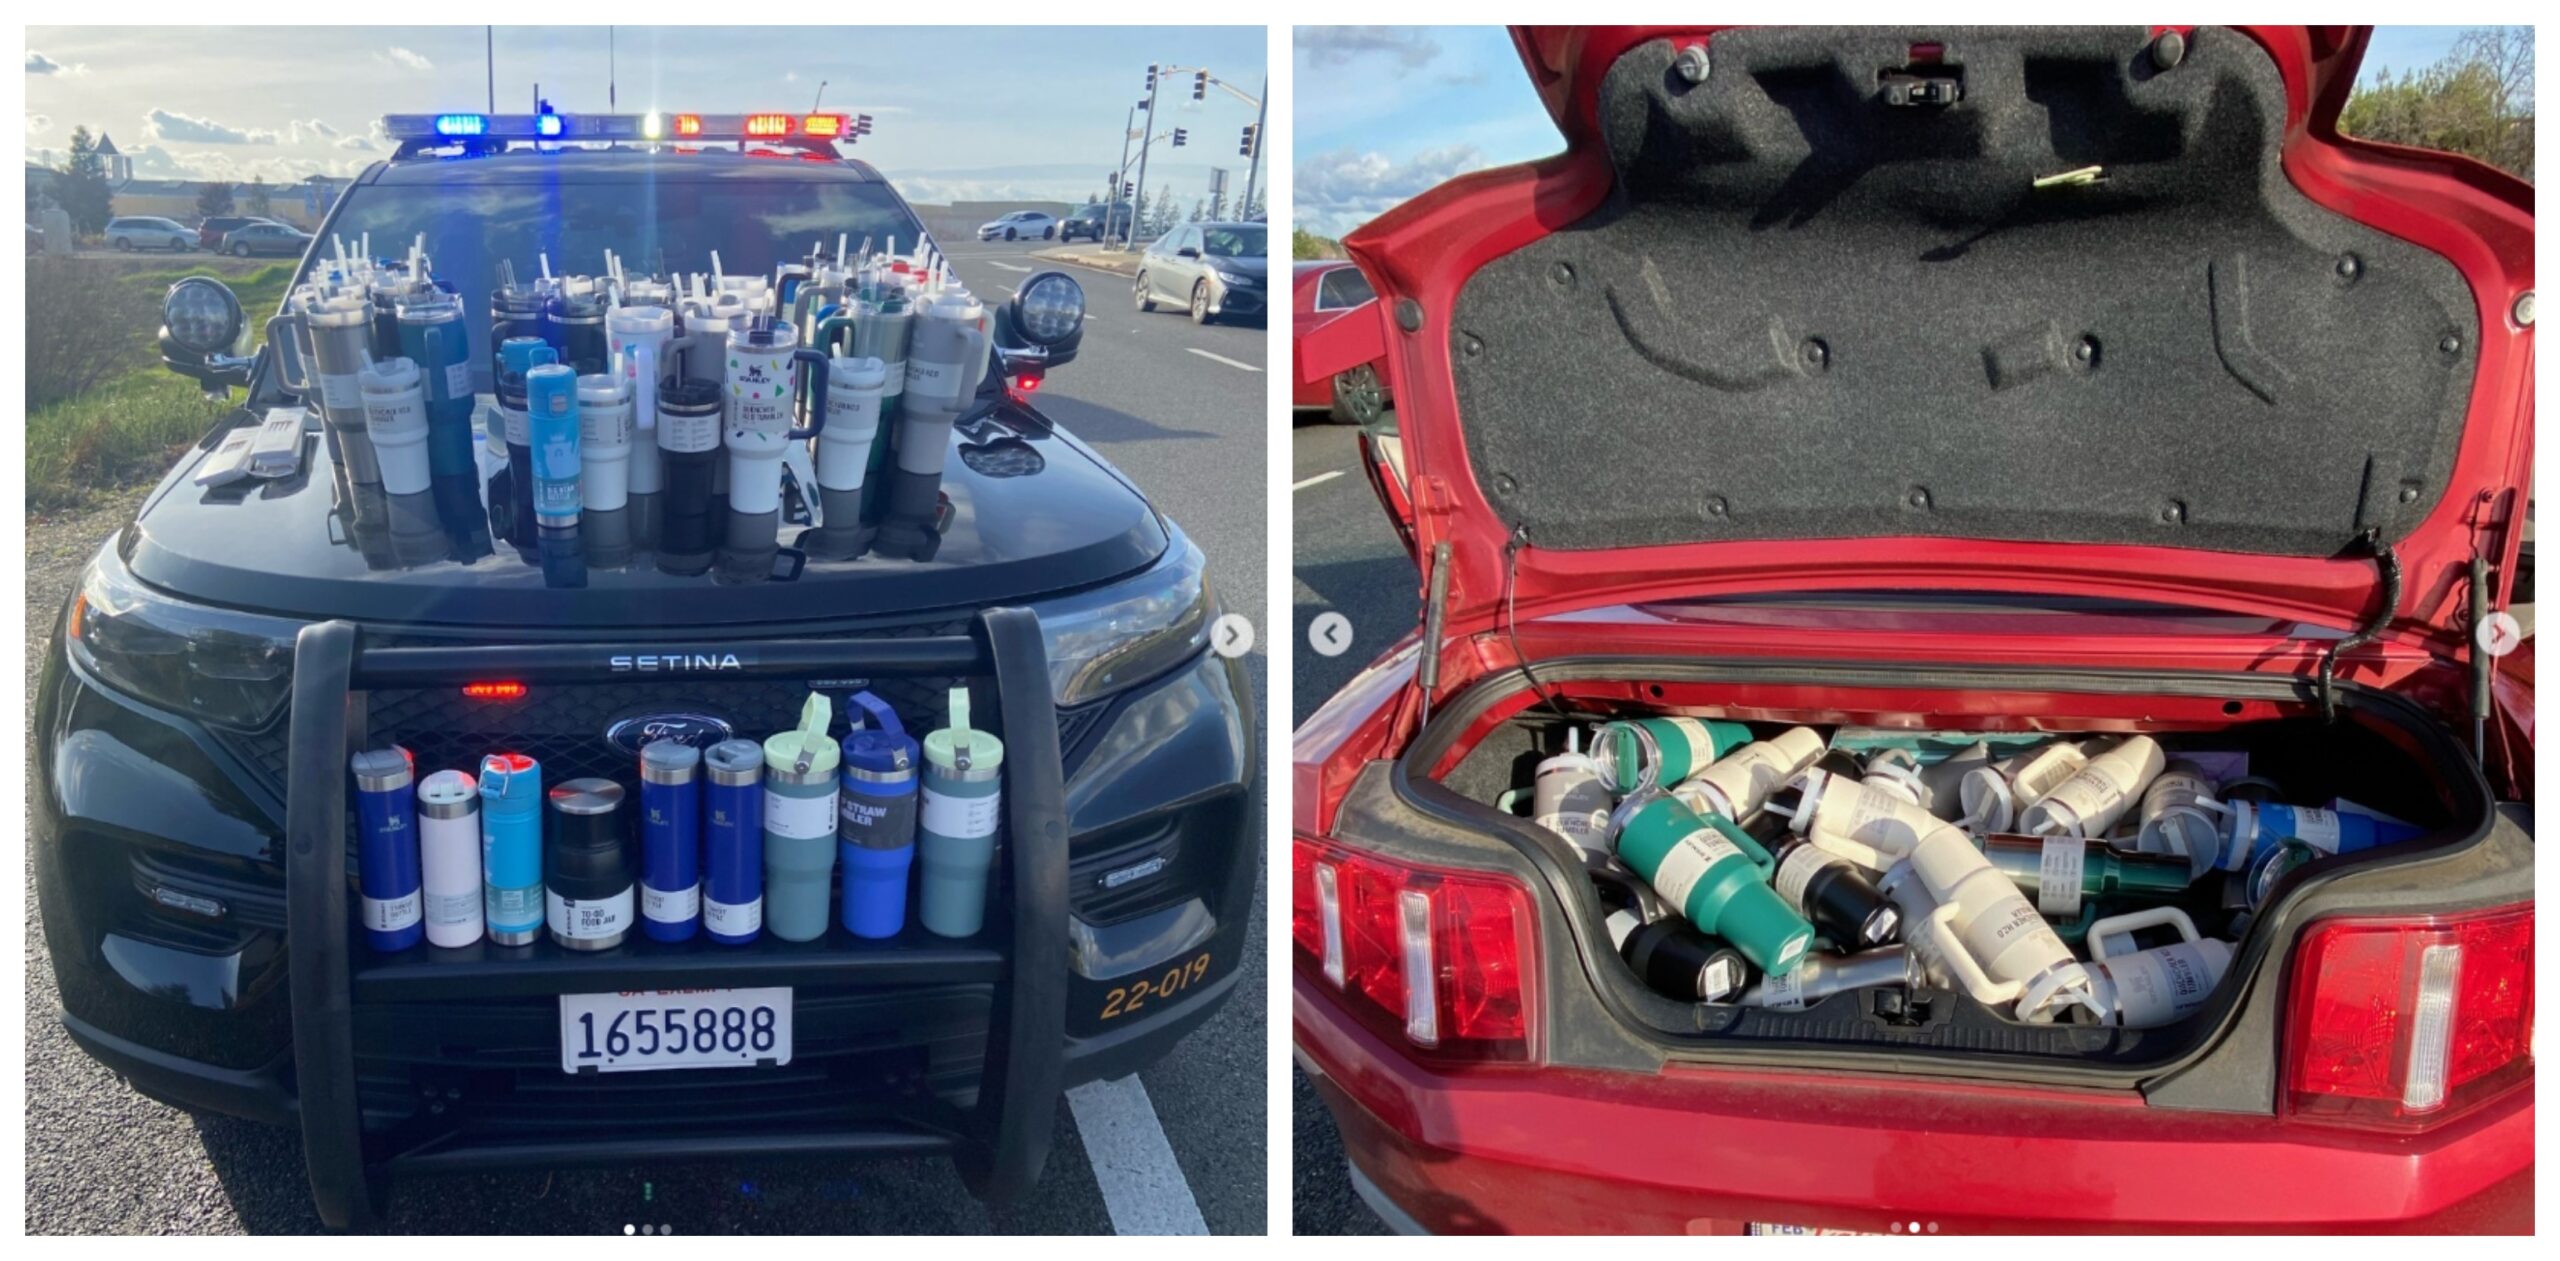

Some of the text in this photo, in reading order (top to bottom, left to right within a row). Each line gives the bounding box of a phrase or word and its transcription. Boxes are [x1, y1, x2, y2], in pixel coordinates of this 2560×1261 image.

[610, 654, 742, 672] SETINA
[847, 801, 888, 818] STRAW
[1100, 952, 1211, 1020] 22-019
[577, 1005, 776, 1058] 1655888
